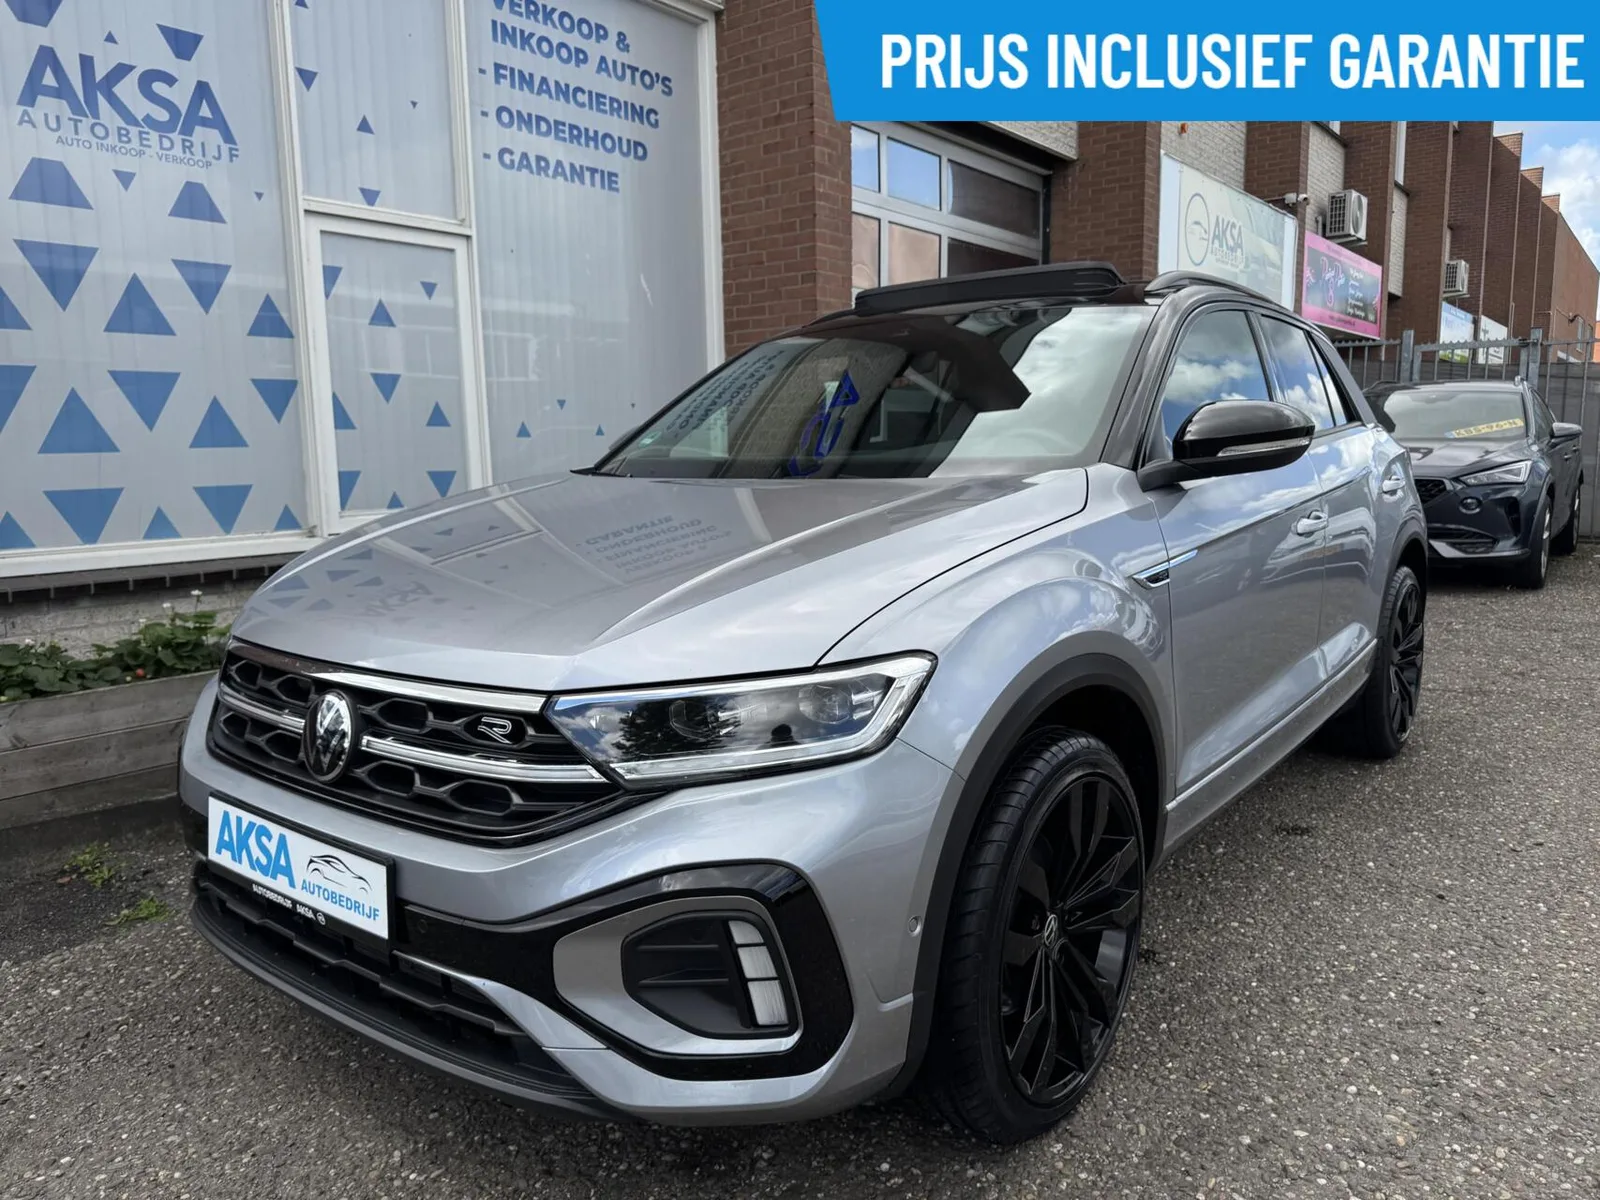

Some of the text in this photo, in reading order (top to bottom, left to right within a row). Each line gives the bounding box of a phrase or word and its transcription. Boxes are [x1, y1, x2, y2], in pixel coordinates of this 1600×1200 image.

[491, 19, 674, 97] INKOOP AUTO'S
[615, 31, 631, 53] &
[16, 44, 238, 146] AKSA
[493, 62, 660, 129] FINANCIERING
[16, 108, 240, 164] AUTOBEDRIJF
[55, 135, 93, 151] AUTO
[95, 141, 147, 160] INKOOP
[155, 152, 213, 170] VERKOOP
[495, 105, 648, 161] ONDERHOUD
[497, 147, 620, 193] GARANTIE
[1211, 215, 1245, 256] AKSA
[215, 810, 296, 889] AKSA
[301, 879, 380, 921] AUTOBEDRIJF
